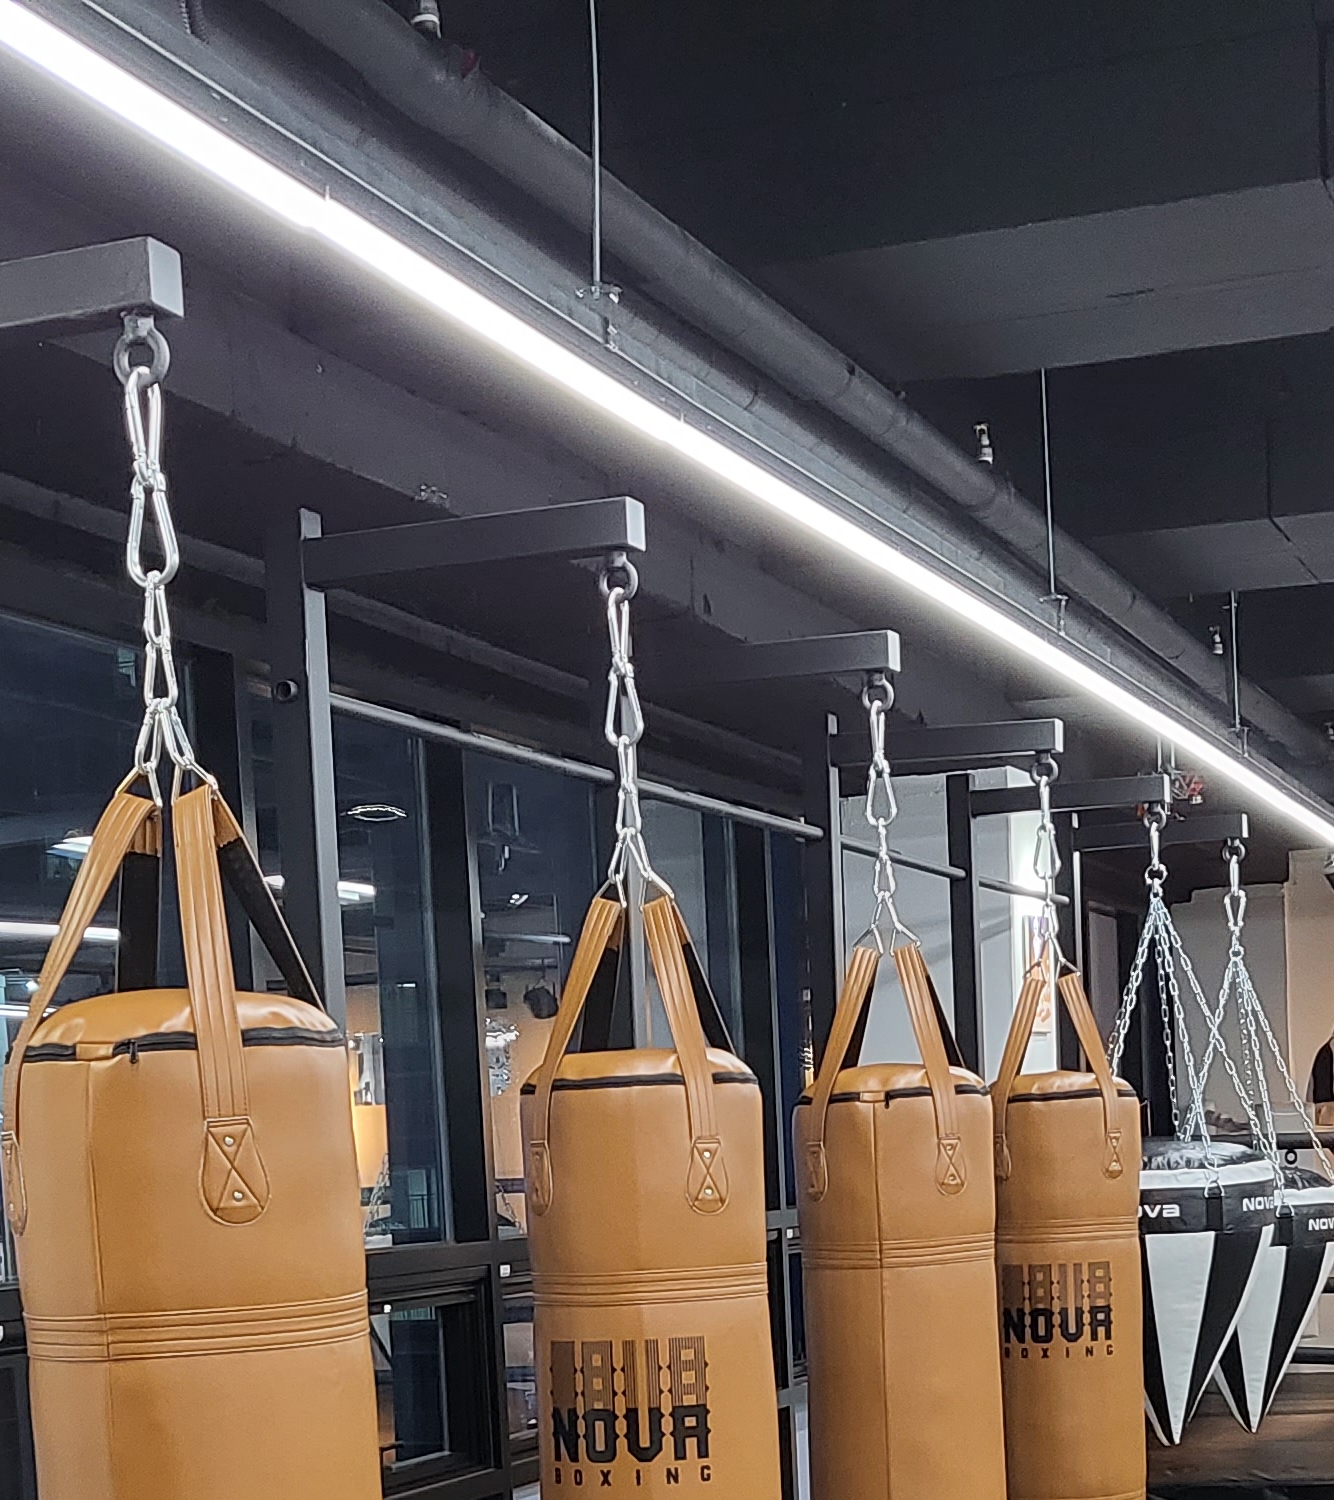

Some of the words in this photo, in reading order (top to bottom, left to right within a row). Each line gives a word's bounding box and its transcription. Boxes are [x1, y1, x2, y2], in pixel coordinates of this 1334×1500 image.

[1003, 1304, 1114, 1344] NOVA
[1004, 1344, 1114, 1359] BOXING
[552, 1403, 712, 1463] NOVA
[554, 1464, 712, 1487] BOXING
